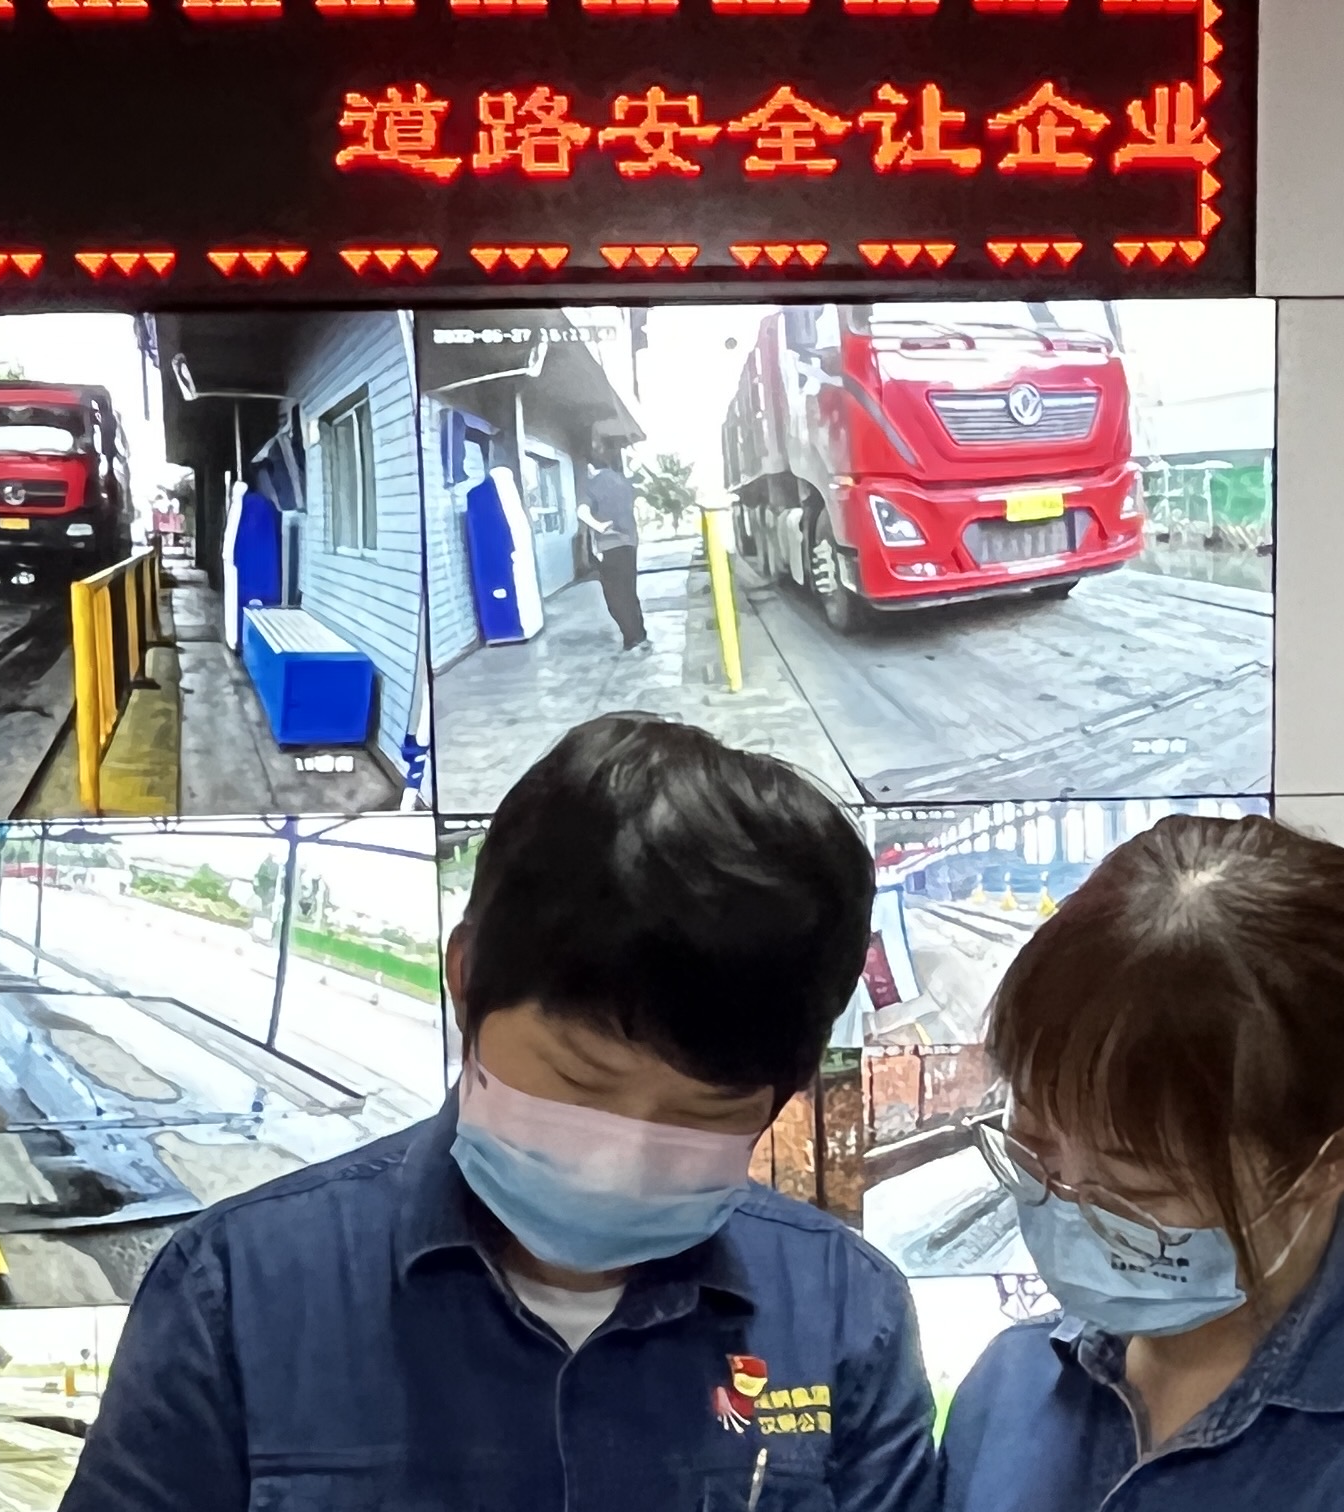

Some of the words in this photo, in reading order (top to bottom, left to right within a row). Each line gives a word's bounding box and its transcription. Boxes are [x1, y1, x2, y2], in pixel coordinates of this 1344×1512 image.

[336, 83, 1214, 178] 道路安全让企业
